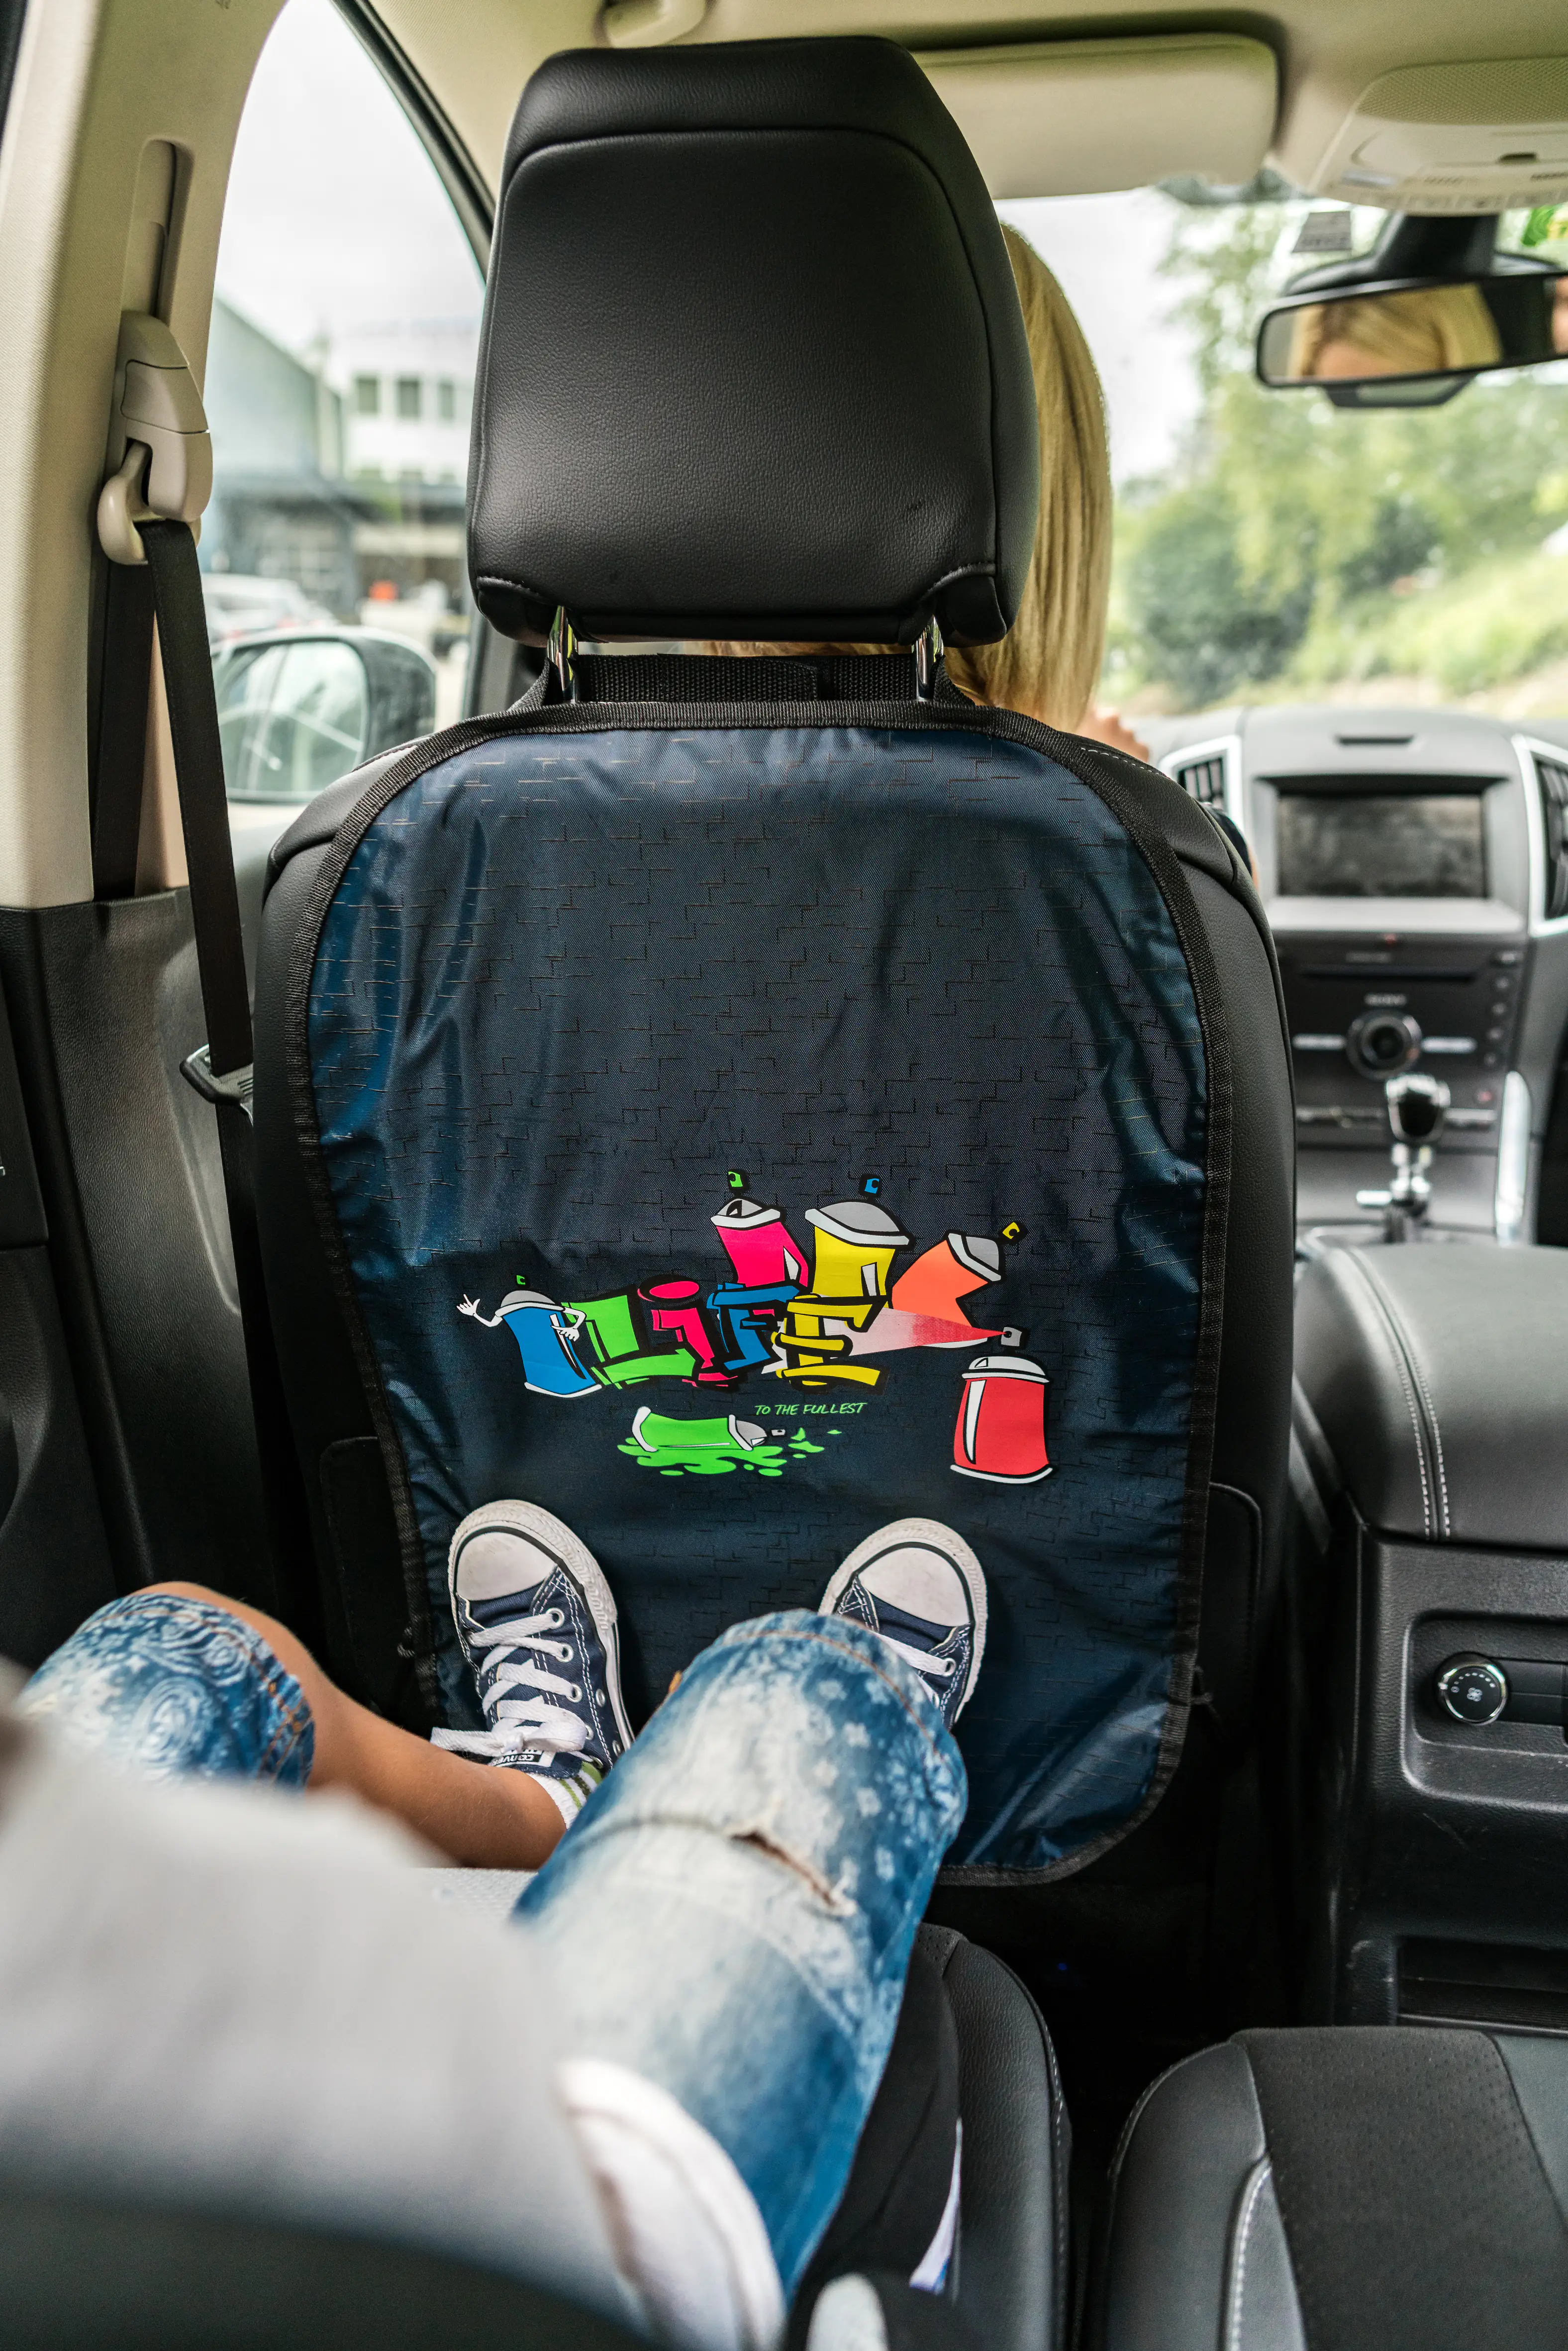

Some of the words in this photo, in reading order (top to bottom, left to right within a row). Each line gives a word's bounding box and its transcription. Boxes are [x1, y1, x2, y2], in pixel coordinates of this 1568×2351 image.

[754, 1405, 771, 1416] TO
[775, 1404, 800, 1415] THE
[803, 1402, 868, 1414] FULLEST
